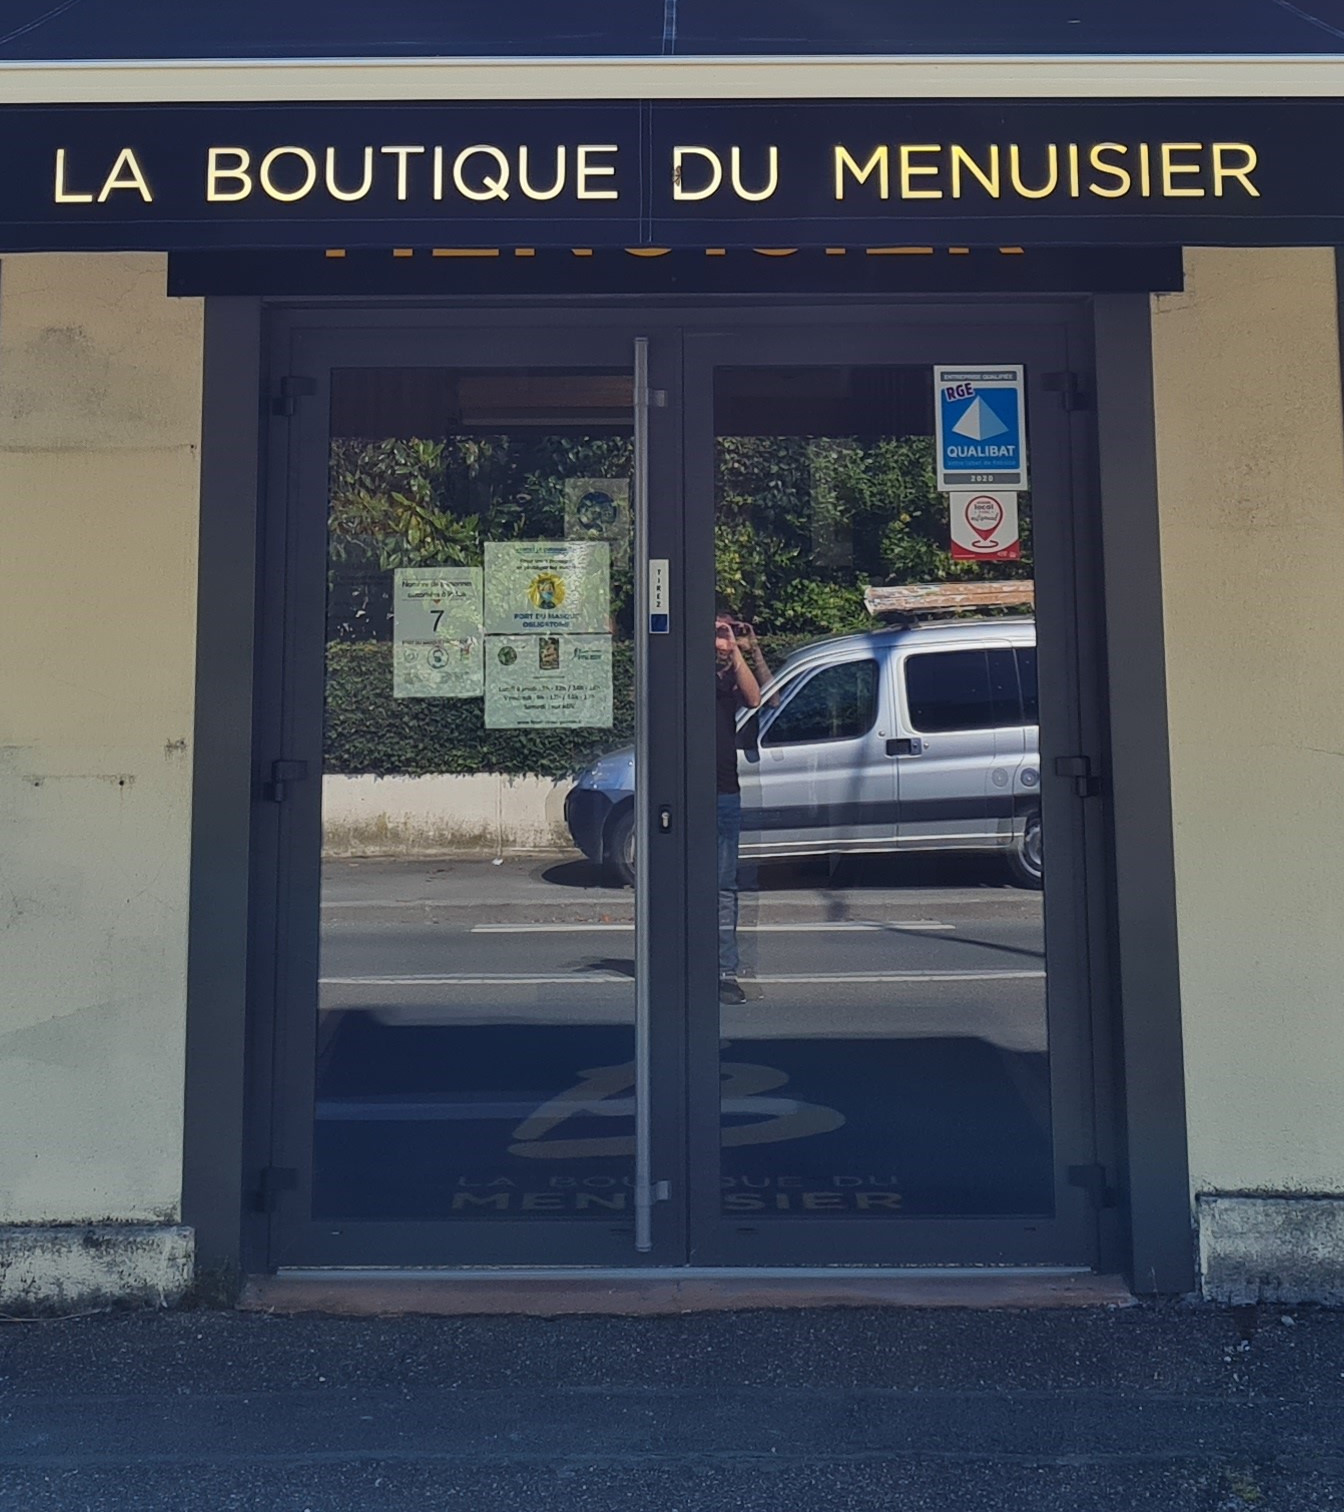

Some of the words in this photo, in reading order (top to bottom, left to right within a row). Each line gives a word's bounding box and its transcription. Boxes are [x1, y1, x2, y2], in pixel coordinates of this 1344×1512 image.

[55, 149, 152, 202] LA
[207, 145, 617, 201] BOUTIQUE
[674, 146, 777, 200] DU
[835, 143, 1259, 199] MENUISIER
[946, 383, 974, 400] RGE
[947, 445, 1016, 458] QUALIBAT
[430, 609, 445, 633] 7
